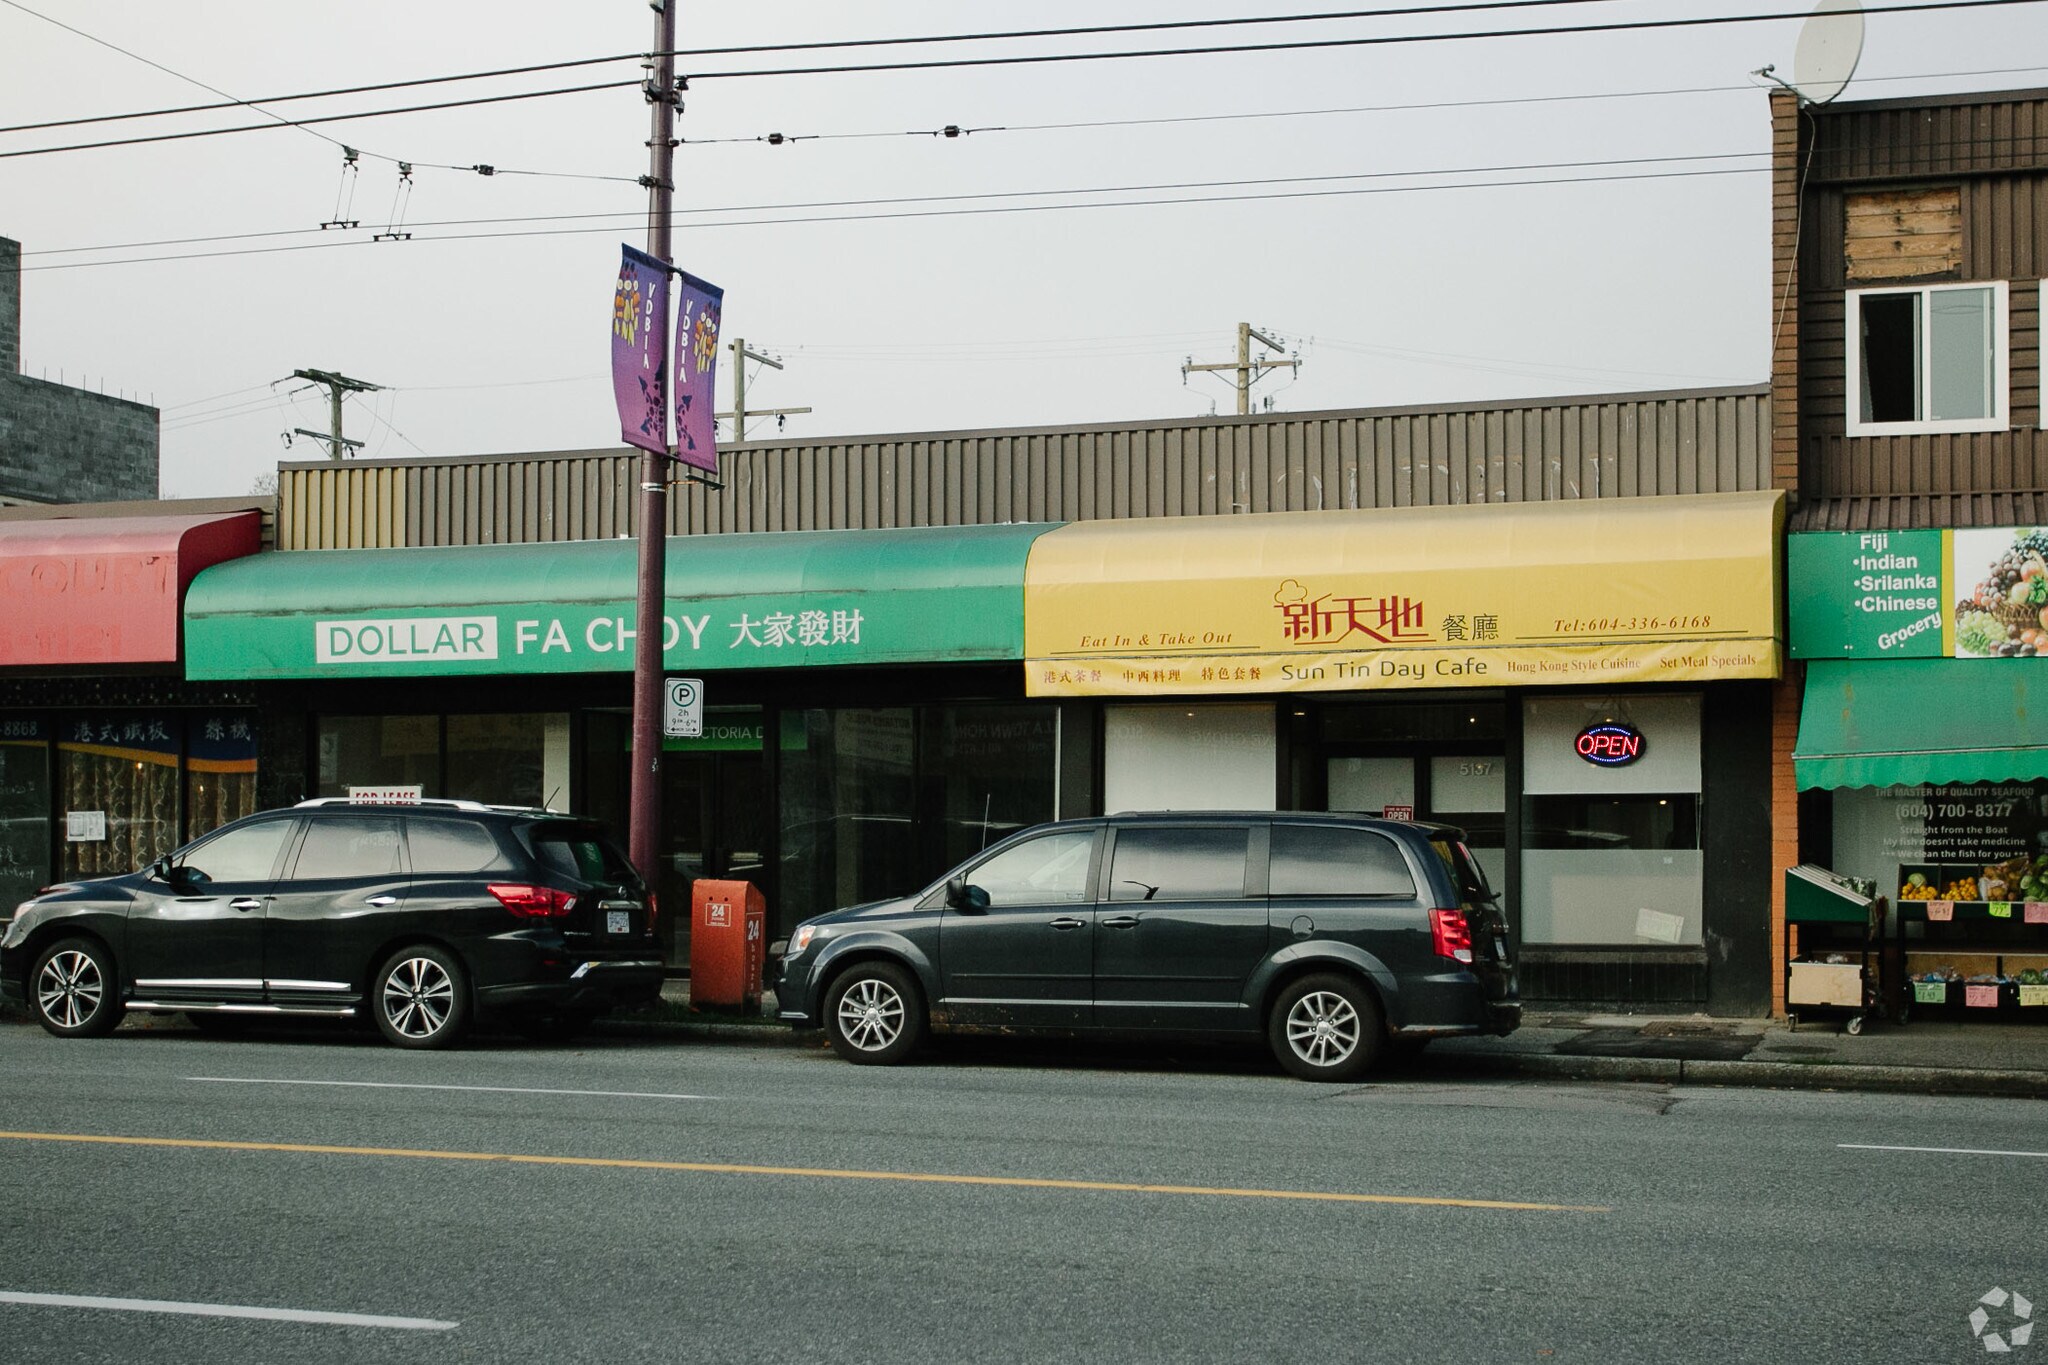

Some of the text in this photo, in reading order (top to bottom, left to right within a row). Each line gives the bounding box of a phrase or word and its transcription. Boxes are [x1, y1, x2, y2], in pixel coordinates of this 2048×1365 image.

[643, 281, 657, 370] VDBIA
[679, 300, 693, 383] VDBIA
[1860, 533, 1888, 553] Fiji
[1860, 554, 1918, 571] Indian
[1860, 574, 1937, 592] Srilanka
[1861, 595, 1938, 613] Chinese
[1274, 593, 1499, 645] 新天地 餐廳
[1554, 615, 1711, 632] Tel:604-336-6168
[729, 608, 864, 649] 大家發財
[1877, 611, 1942, 650] Grocery
[330, 623, 485, 656] DOLLAR
[516, 619, 572, 654] FA
[1080, 631, 1233, 648] Eat In & Take Out
[1281, 657, 1488, 681] Sun Tin Day Cafe
[1507, 653, 1757, 675] Hong Kong Style Cuisine Set Meal Specials
[1122, 669, 1182, 683] 中西料理
[1201, 666, 1262, 682] 特色套餐
[678, 688, 690, 702] P
[677, 708, 689, 717] 2h
[1577, 734, 1639, 756] OPEN
[1459, 762, 1492, 776] 5137
[1875, 786, 2035, 797] THE MASTER OF QUALITY SEAFOOD
[1387, 811, 1409, 821] OPEN
[1895, 803, 2013, 820] (604) 700-8377
[1899, 825, 2008, 836] Straight from the Boat
[1900, 837, 1920, 846] fish
[1923, 837, 1955, 846] doesn't
[1957, 837, 1979, 846] take
[1981, 837, 2026, 846] medicine
[1914, 850, 1939, 858] clean
[1941, 850, 1957, 858] the
[1959, 849, 1976, 858] fish
[1978, 849, 1992, 858] for
[1993, 851, 2012, 860] you
[711, 904, 725, 917] 24
[747, 920, 760, 941] 24
